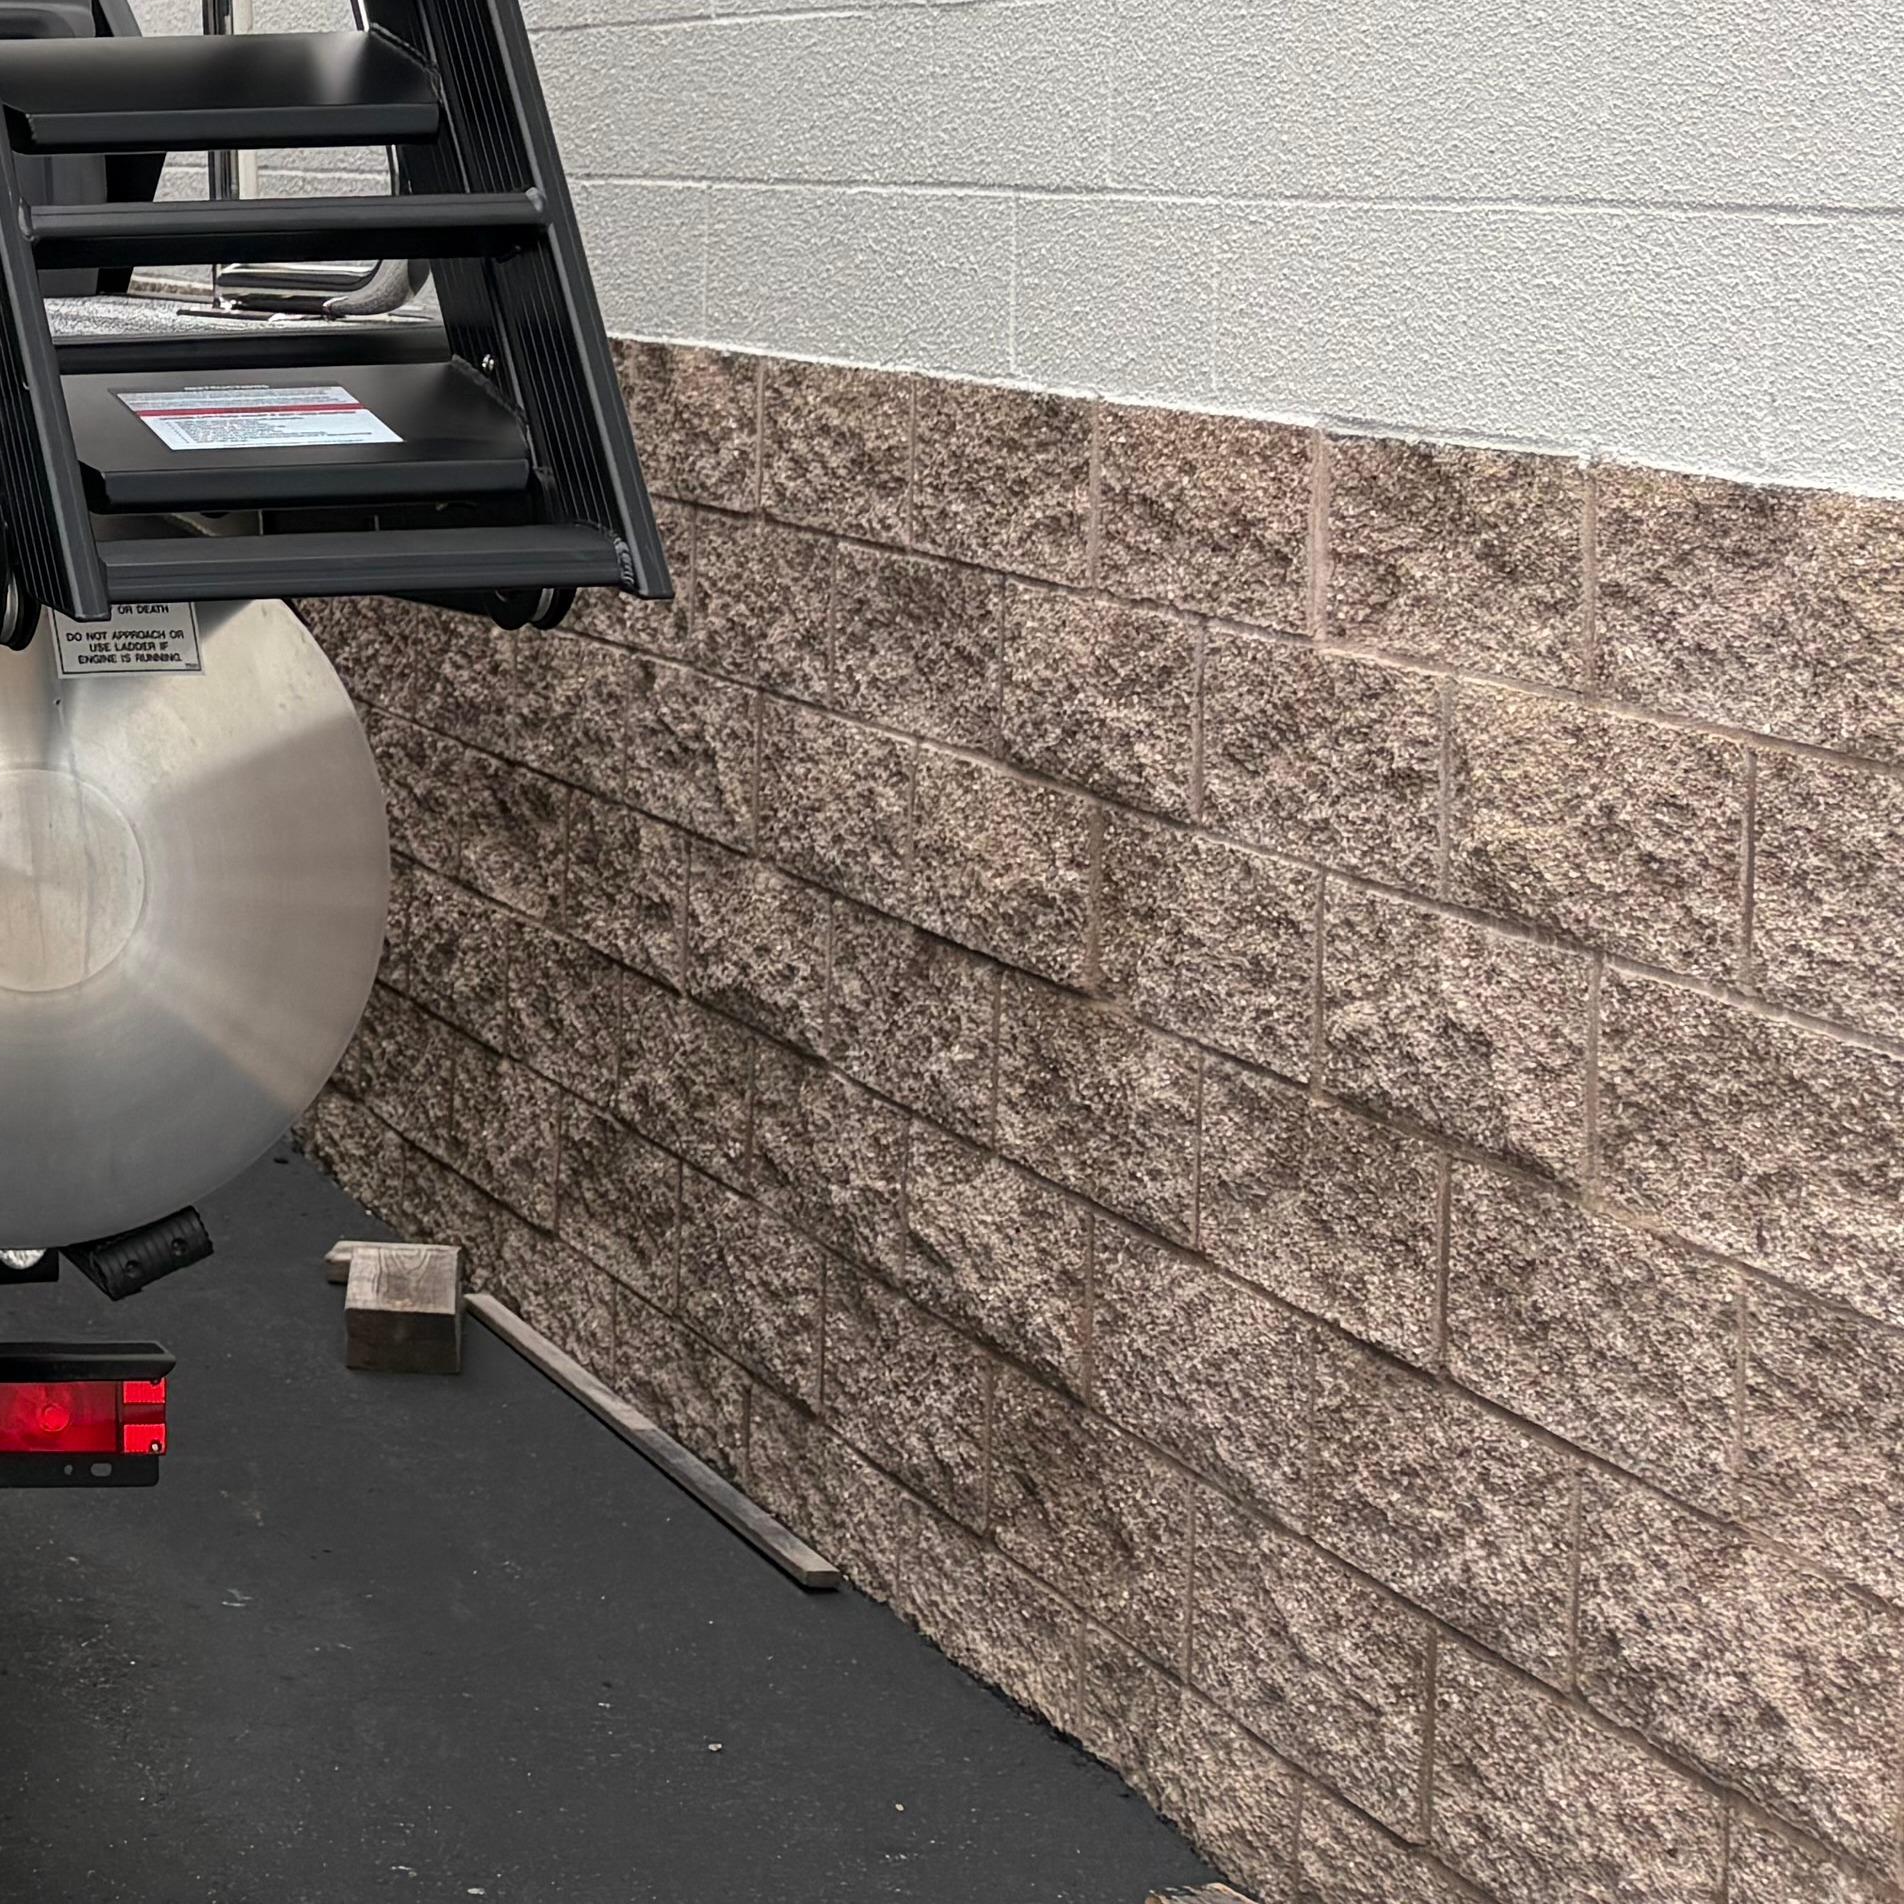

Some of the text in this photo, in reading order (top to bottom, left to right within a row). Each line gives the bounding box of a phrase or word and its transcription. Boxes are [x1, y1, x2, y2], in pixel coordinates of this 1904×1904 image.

[136, 604, 170, 614] DEATH
[65, 629, 185, 642] DO NOT APPROACH OR
[89, 641, 169, 652] USE LADDER IF
[78, 654, 118, 664] ENGINE
[120, 653, 132, 663] IS
